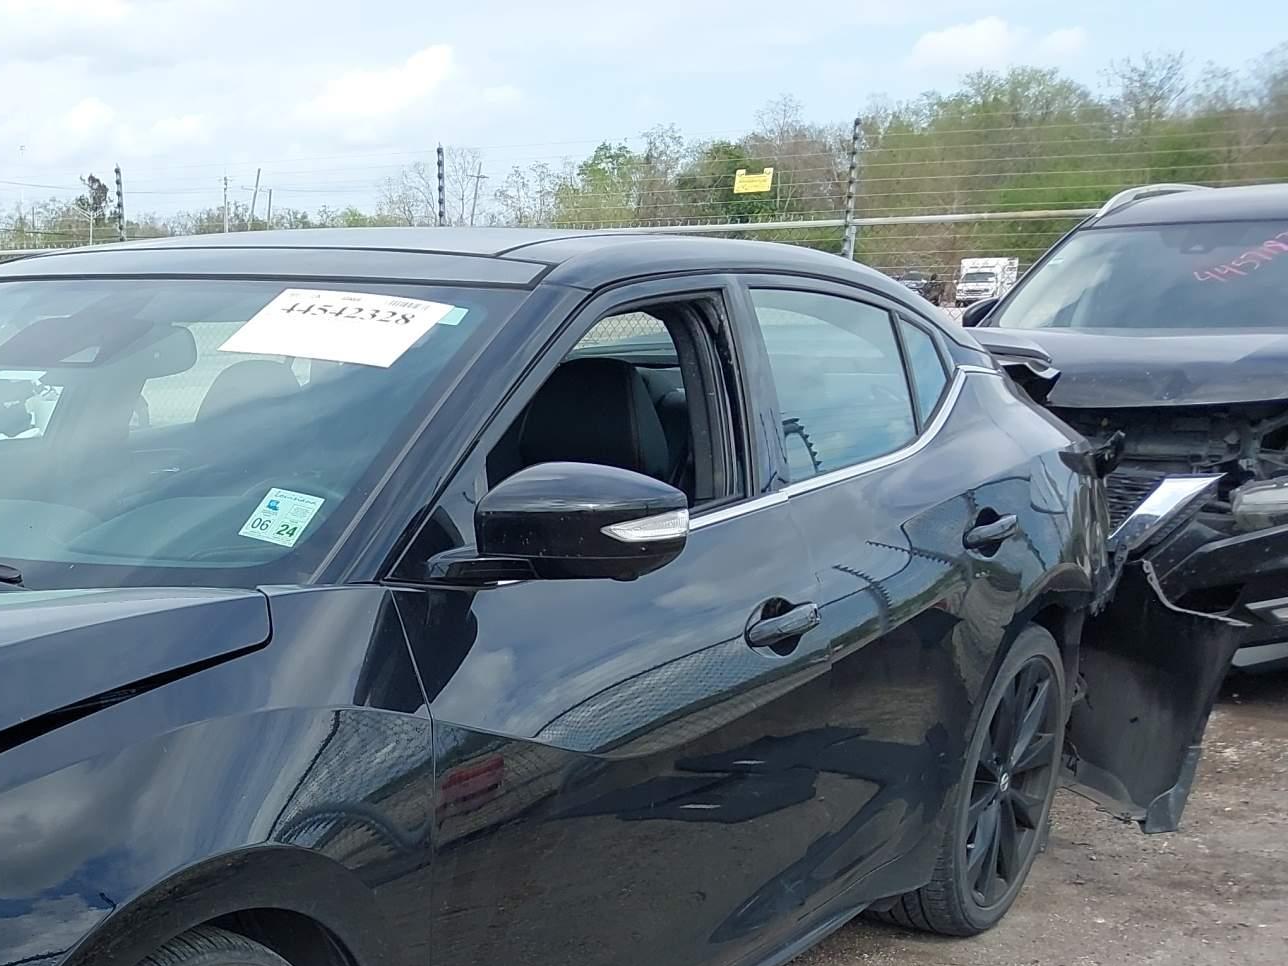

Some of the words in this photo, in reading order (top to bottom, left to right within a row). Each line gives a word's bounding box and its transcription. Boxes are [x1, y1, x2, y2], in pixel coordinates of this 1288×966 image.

[281, 302, 415, 326] 44542328
[251, 517, 272, 531] 06
[276, 524, 298, 537] 24
